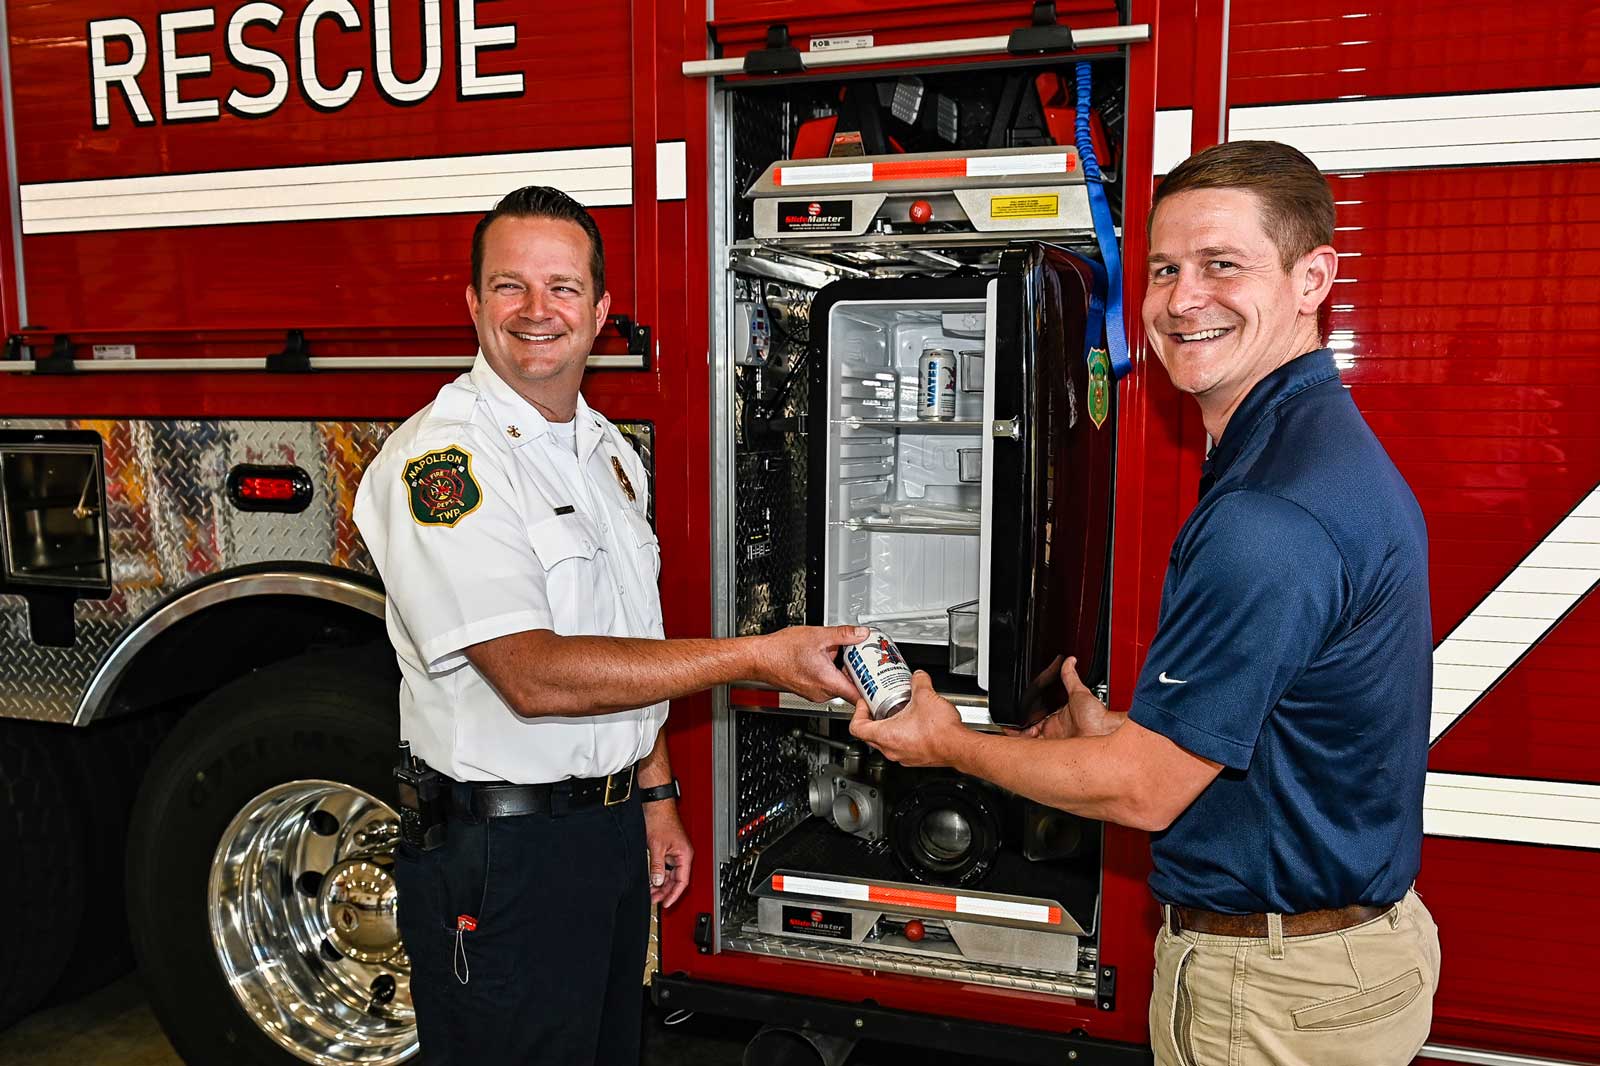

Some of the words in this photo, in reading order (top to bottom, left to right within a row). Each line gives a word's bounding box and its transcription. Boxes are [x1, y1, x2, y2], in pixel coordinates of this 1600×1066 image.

[88, 0, 525, 127] RESCUE
[926, 361, 938, 408] WATER
[408, 453, 463, 480] NAPOLEON
[430, 471, 444, 480] FIRE
[847, 645, 879, 702] WATER
